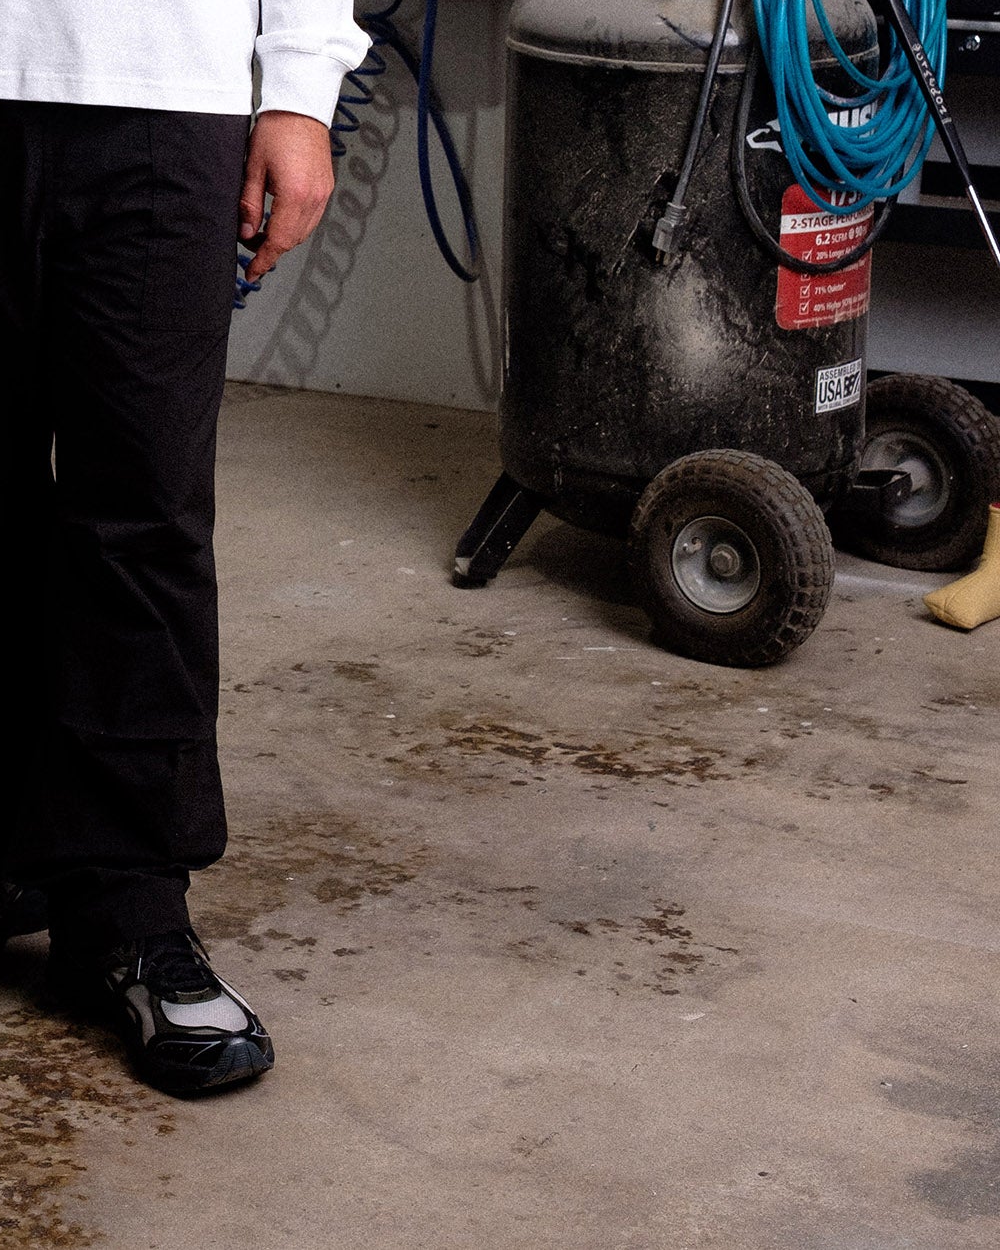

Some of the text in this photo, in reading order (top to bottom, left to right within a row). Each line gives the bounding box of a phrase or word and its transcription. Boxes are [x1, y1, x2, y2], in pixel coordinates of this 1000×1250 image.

[790, 215, 835, 230] 2-STAGE
[815, 233, 831, 246] 6.2
[819, 377, 842, 403] USA
